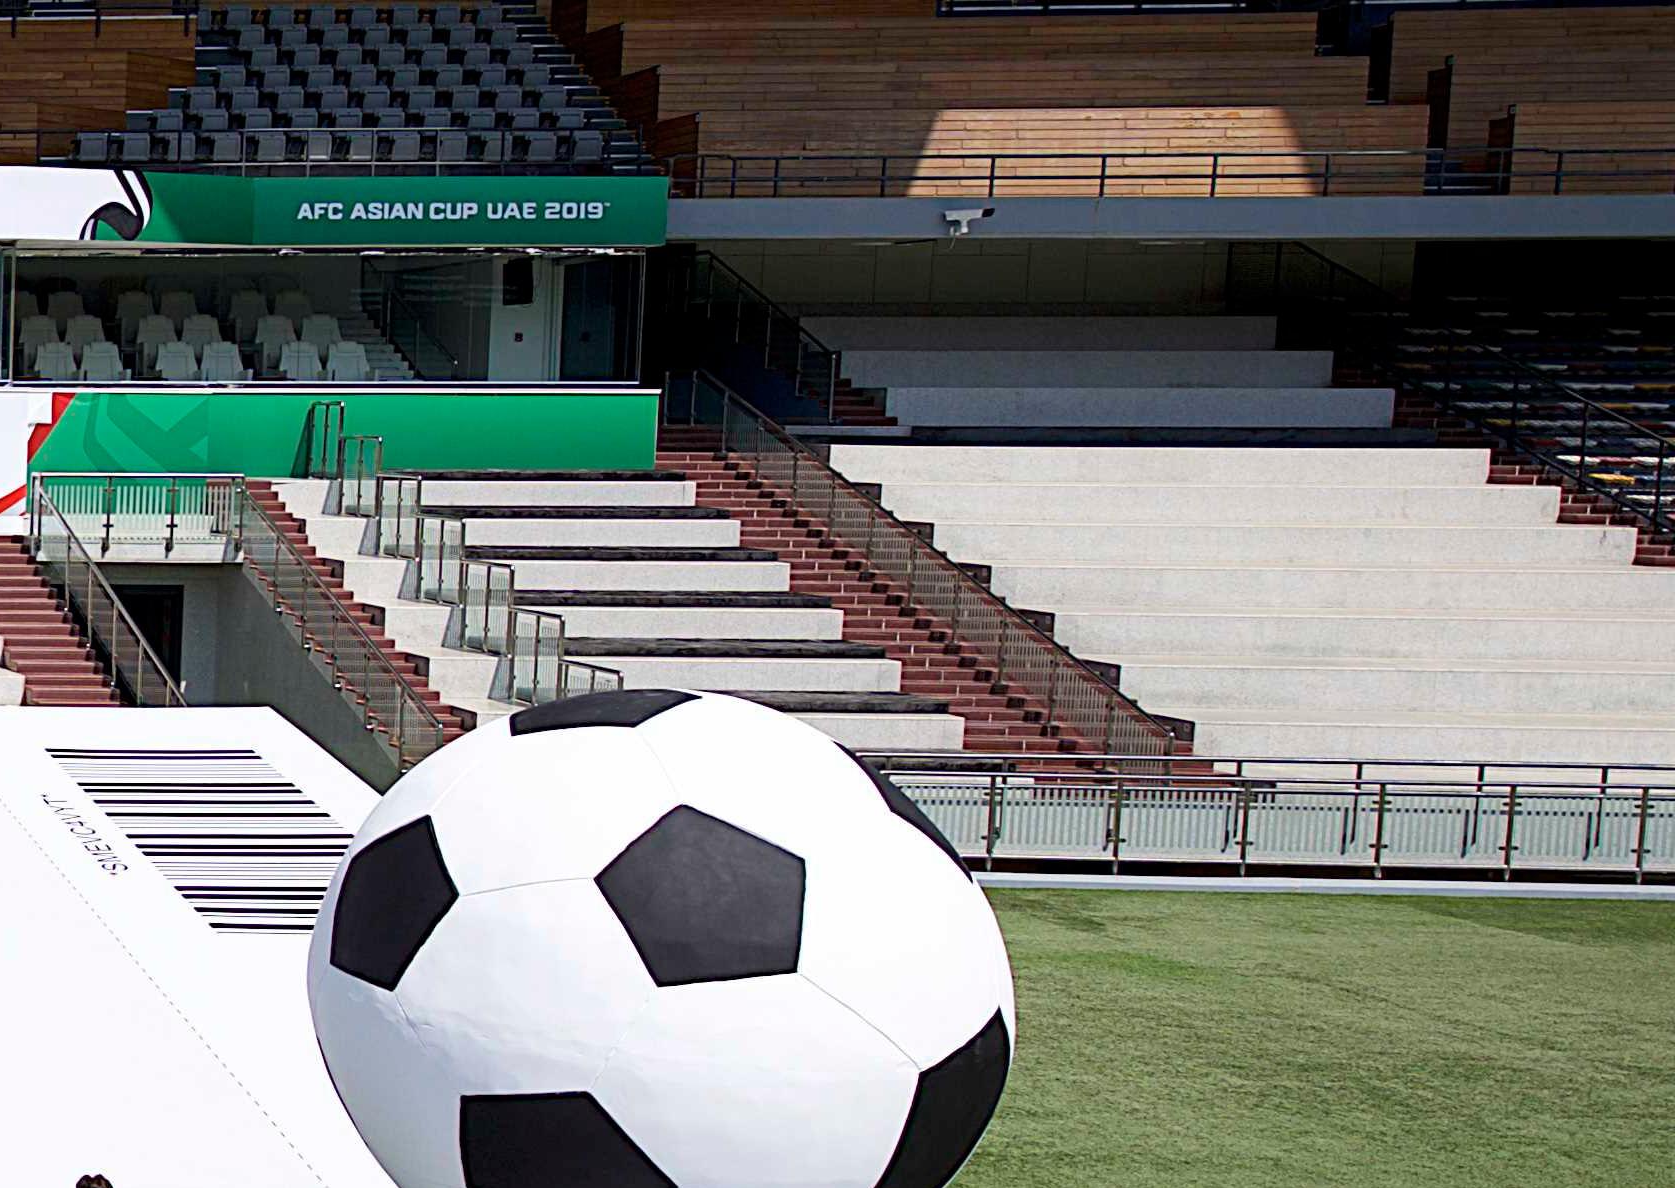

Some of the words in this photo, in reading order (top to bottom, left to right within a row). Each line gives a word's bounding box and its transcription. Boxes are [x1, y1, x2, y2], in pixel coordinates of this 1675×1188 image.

[298, 203, 343, 219] AFC
[350, 203, 423, 219] ASIAN
[430, 203, 478, 219] CUP
[488, 203, 536, 219] UAE
